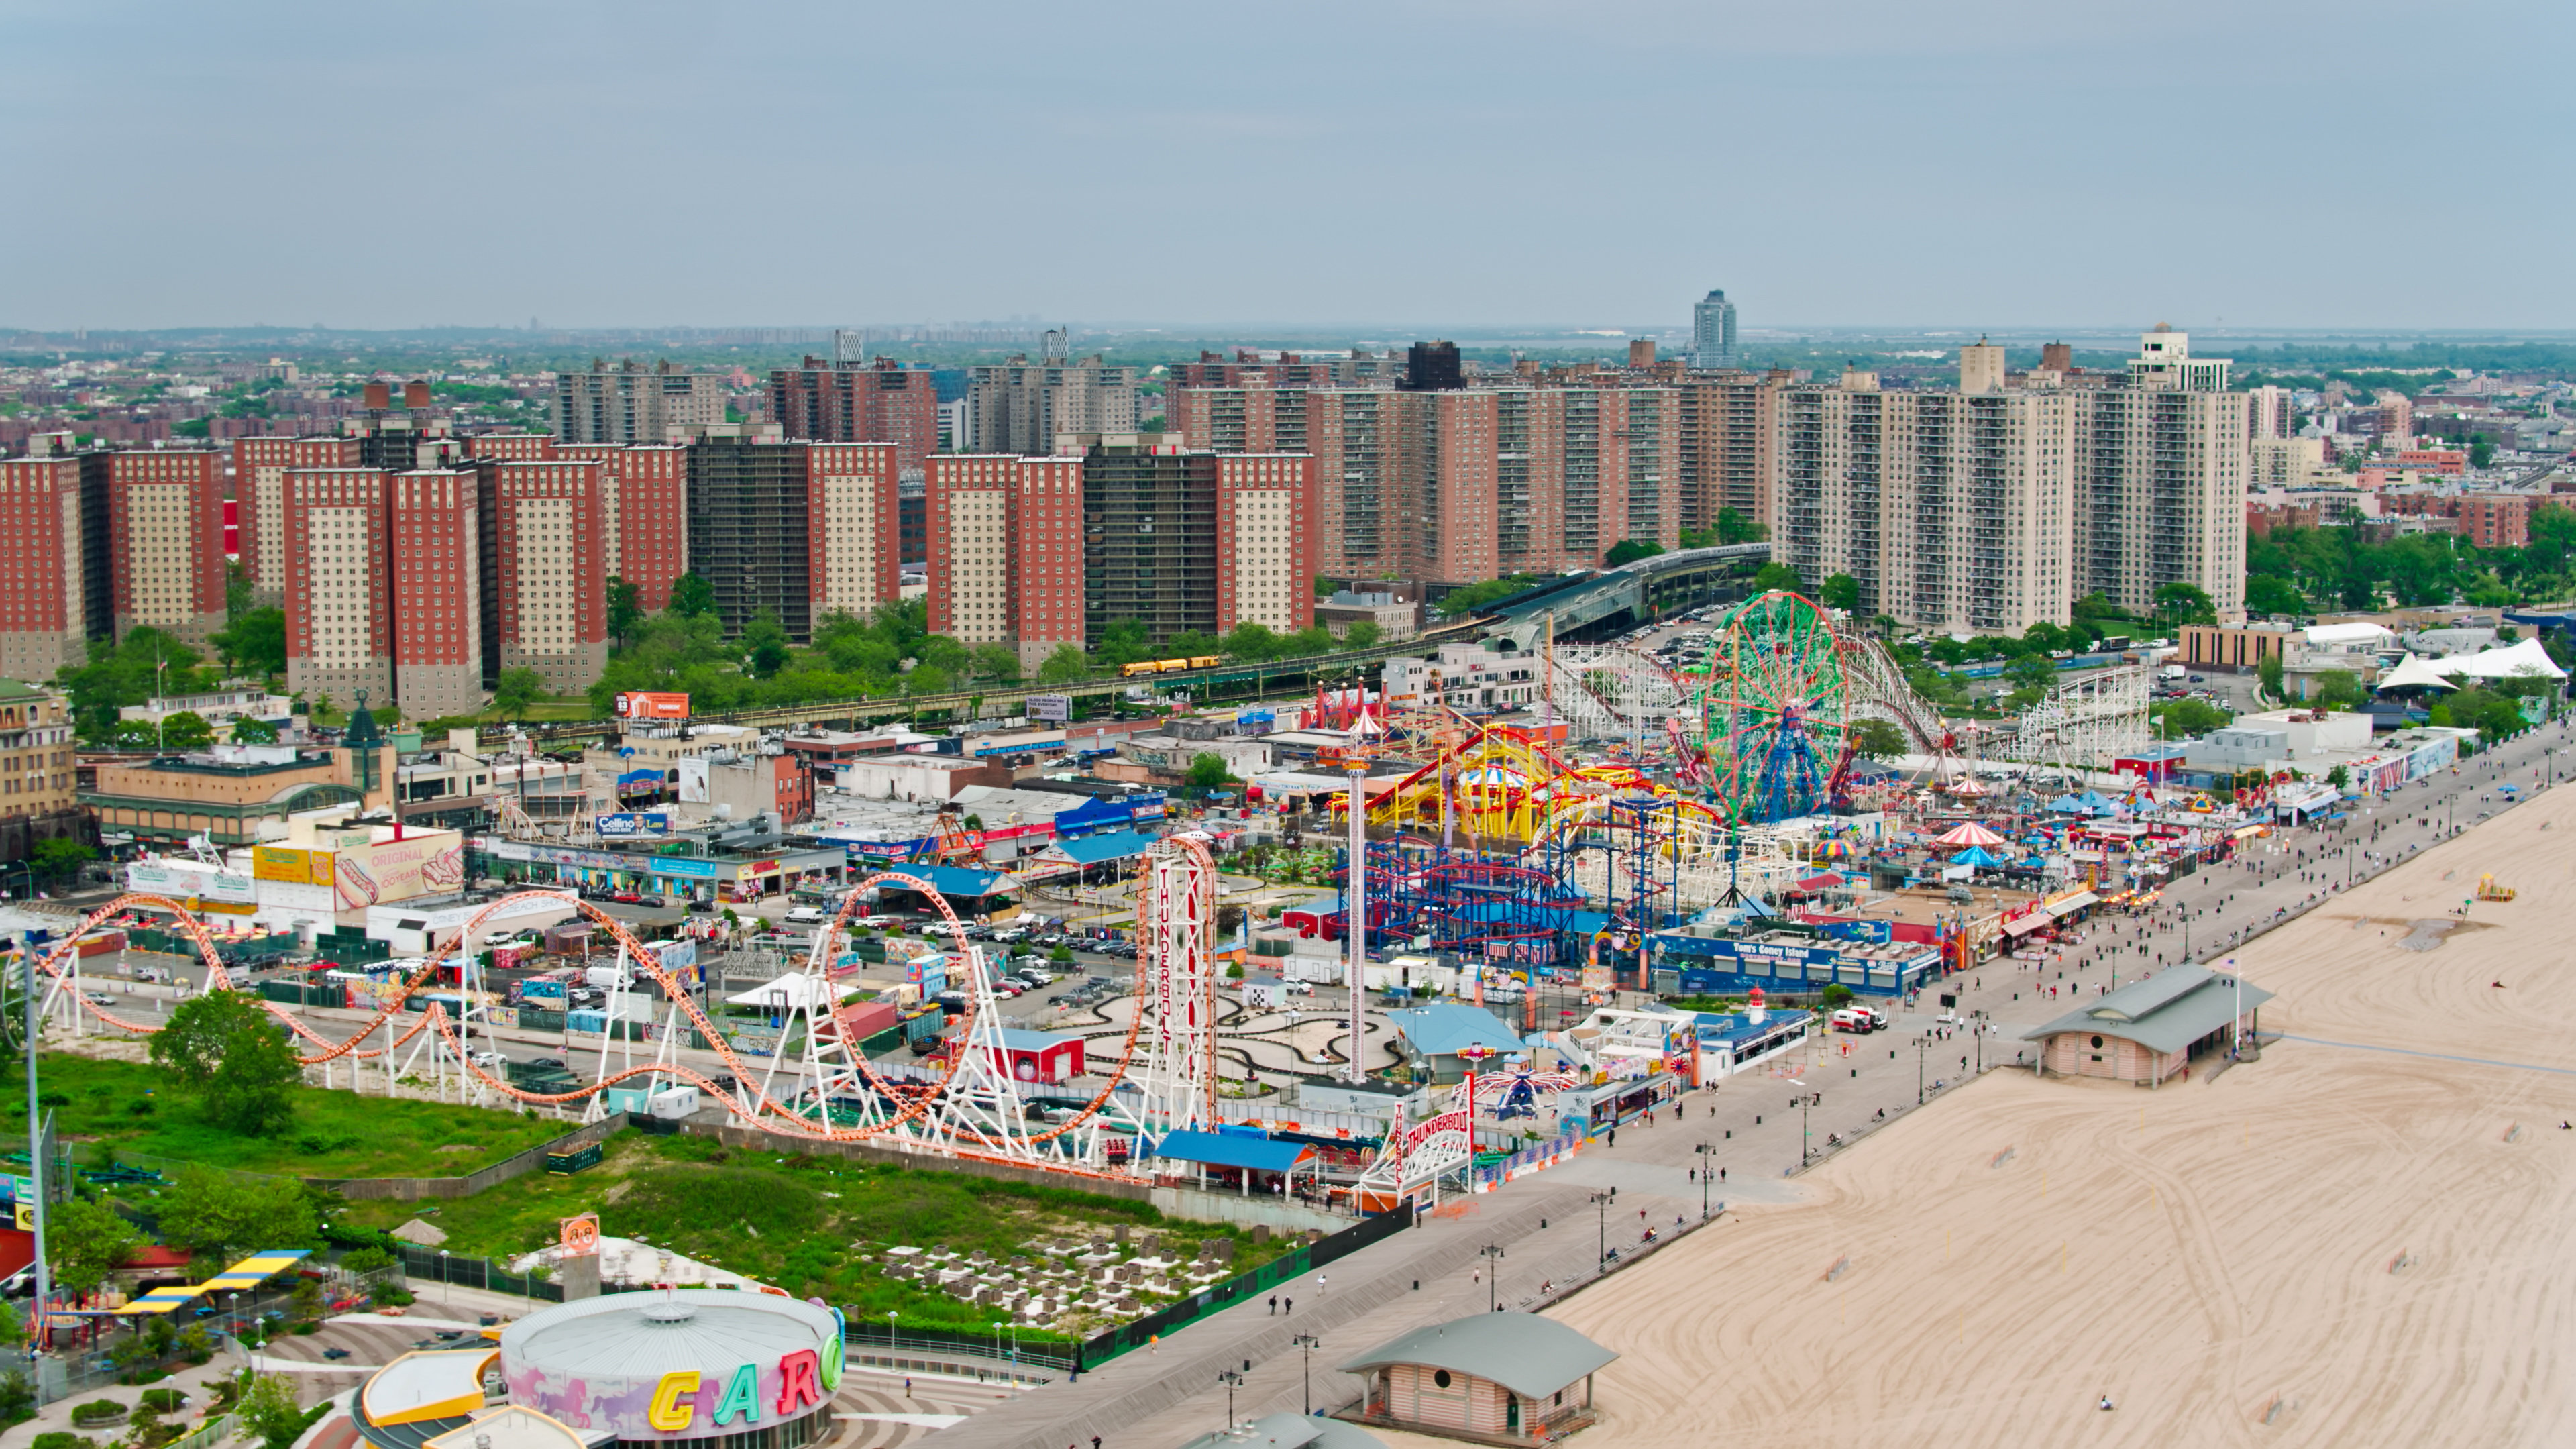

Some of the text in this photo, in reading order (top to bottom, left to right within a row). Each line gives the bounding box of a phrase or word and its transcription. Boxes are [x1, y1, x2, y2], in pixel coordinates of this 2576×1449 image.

[598, 816, 665, 828] Cellino Law
[372, 848, 424, 867] ORIGINAL
[509, 902, 537, 912] BEACH
[1733, 942, 1809, 958] Tom's Coney Island
[1160, 869, 1171, 1055] THUNDERBOLT
[1408, 1110, 1468, 1157] THUNDERBOLT
